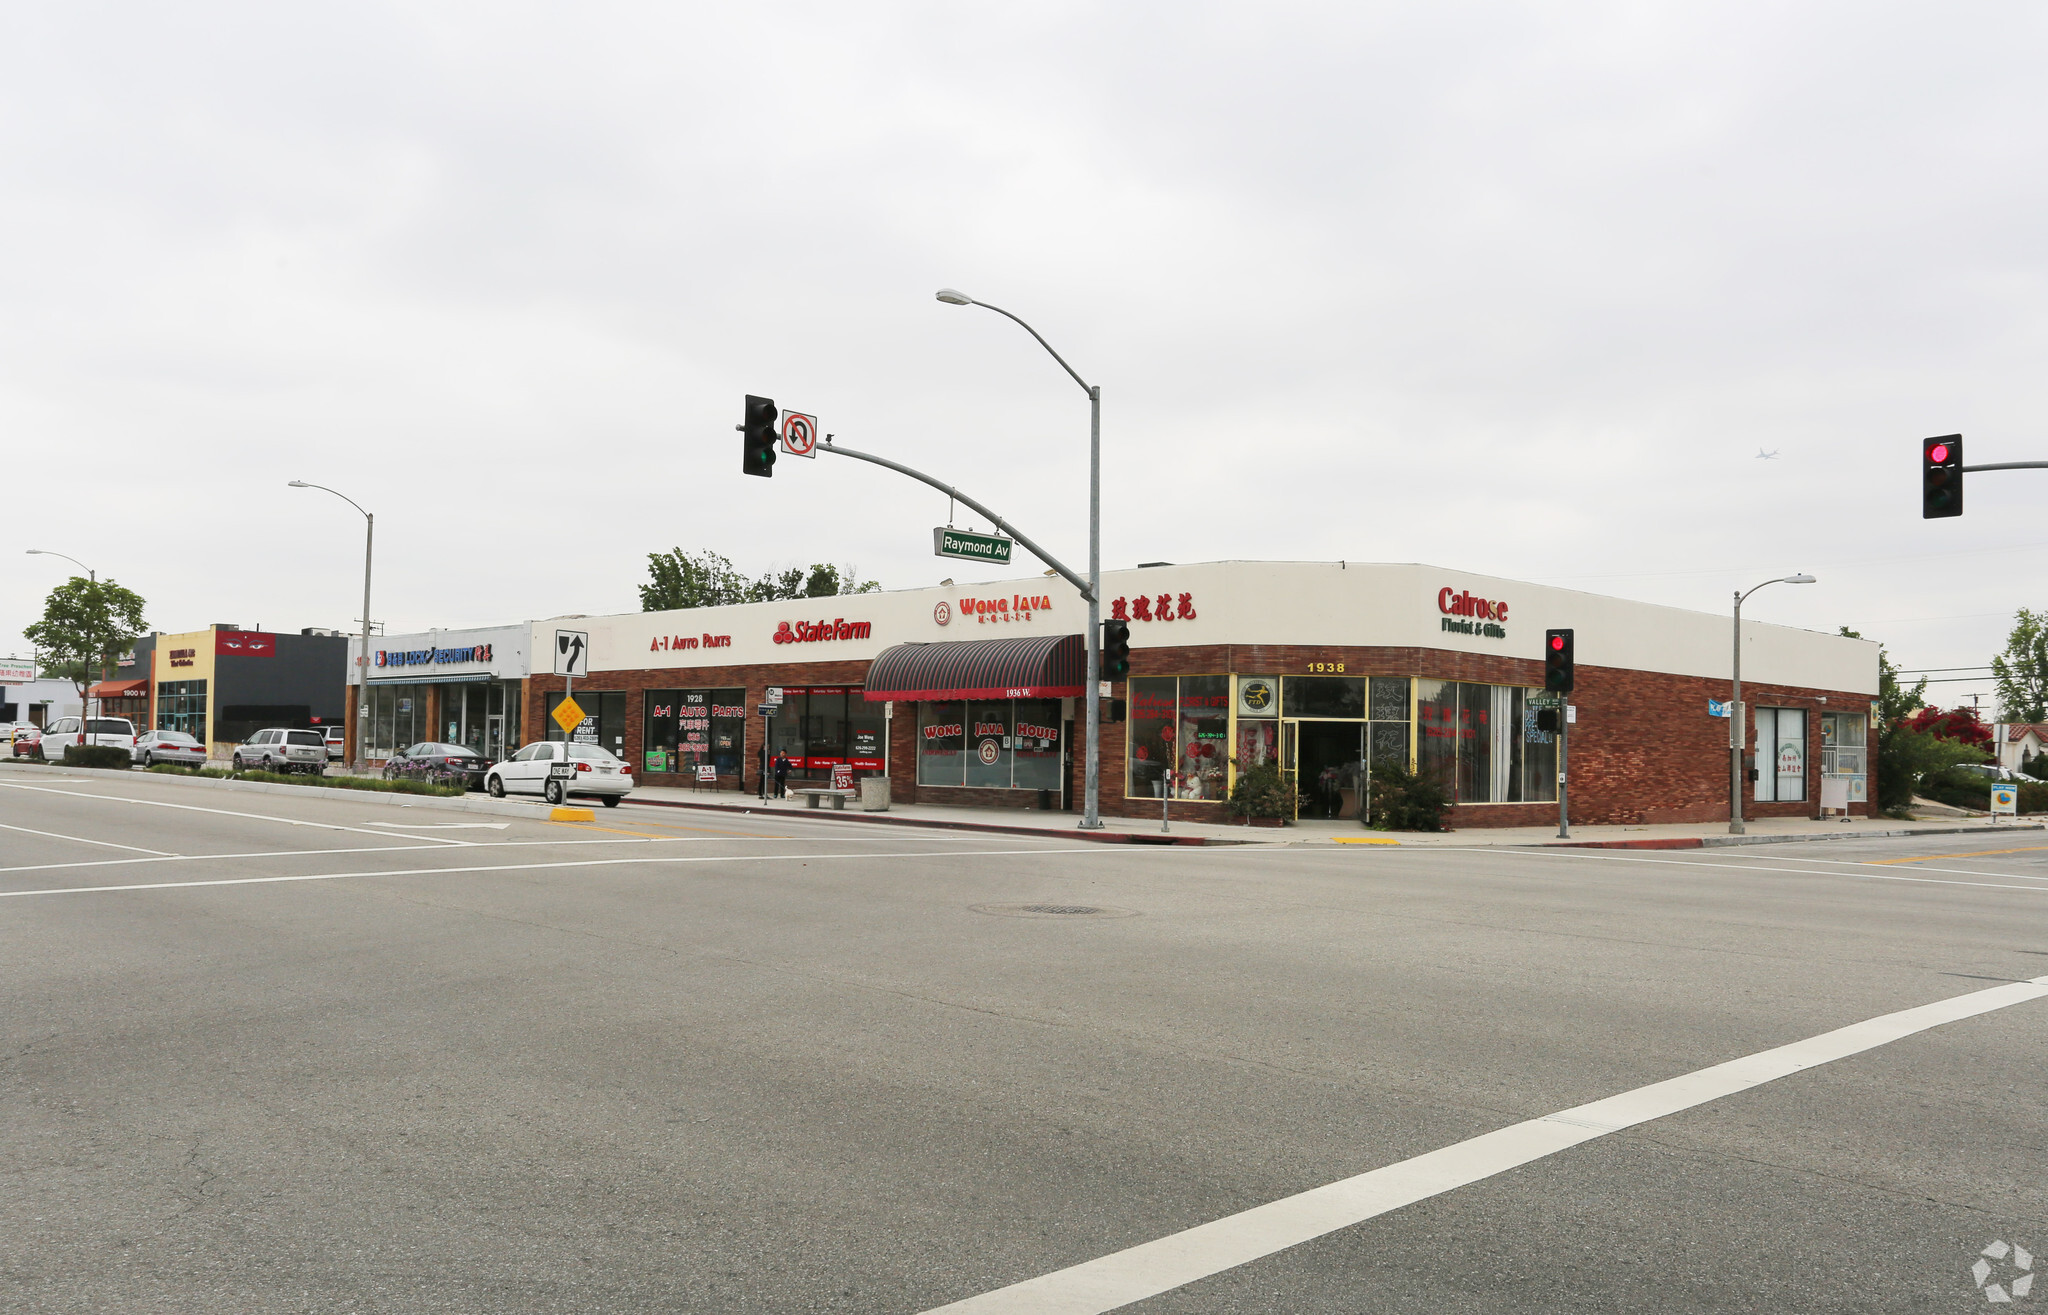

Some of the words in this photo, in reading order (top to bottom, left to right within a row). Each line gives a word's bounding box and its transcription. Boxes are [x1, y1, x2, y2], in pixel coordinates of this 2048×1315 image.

[944, 535, 992, 554] Raymond
[994, 543, 1008, 556] Av
[959, 598, 1008, 615] WONG
[1012, 594, 1052, 612] JAVA
[1111, 592, 1197, 622] 玫瑰花苑
[1438, 587, 1509, 622] Calrose
[1441, 617, 1475, 635] Florist
[1474, 621, 1483, 636] &
[1483, 622, 1506, 639] Gifts
[650, 636, 669, 652] A-1
[672, 634, 698, 650] AUTO
[702, 633, 731, 649] PARTS
[405, 649, 428, 666] LOCK
[433, 646, 476, 663] SECURITY
[1307, 662, 1345, 673] 1938
[123, 689, 139, 697] 1900
[687, 695, 703, 703] 1928
[1006, 688, 1021, 697] 1936
[1022, 688, 1031, 697] W.
[1178, 696, 1203, 707] FLORIST
[1210, 696, 1229, 707] GIFTS
[653, 705, 671, 717] A-1
[679, 705, 707, 717] AUTO
[711, 704, 745, 717] PARTS
[579, 717, 593, 726] FOR
[576, 726, 596, 735] RENT
[924, 724, 962, 739] WONG
[974, 721, 1004, 737] JAVA
[1017, 723, 1058, 741] HOUSE
[553, 766, 561, 774] ONE
[836, 775, 853, 788] 35%
